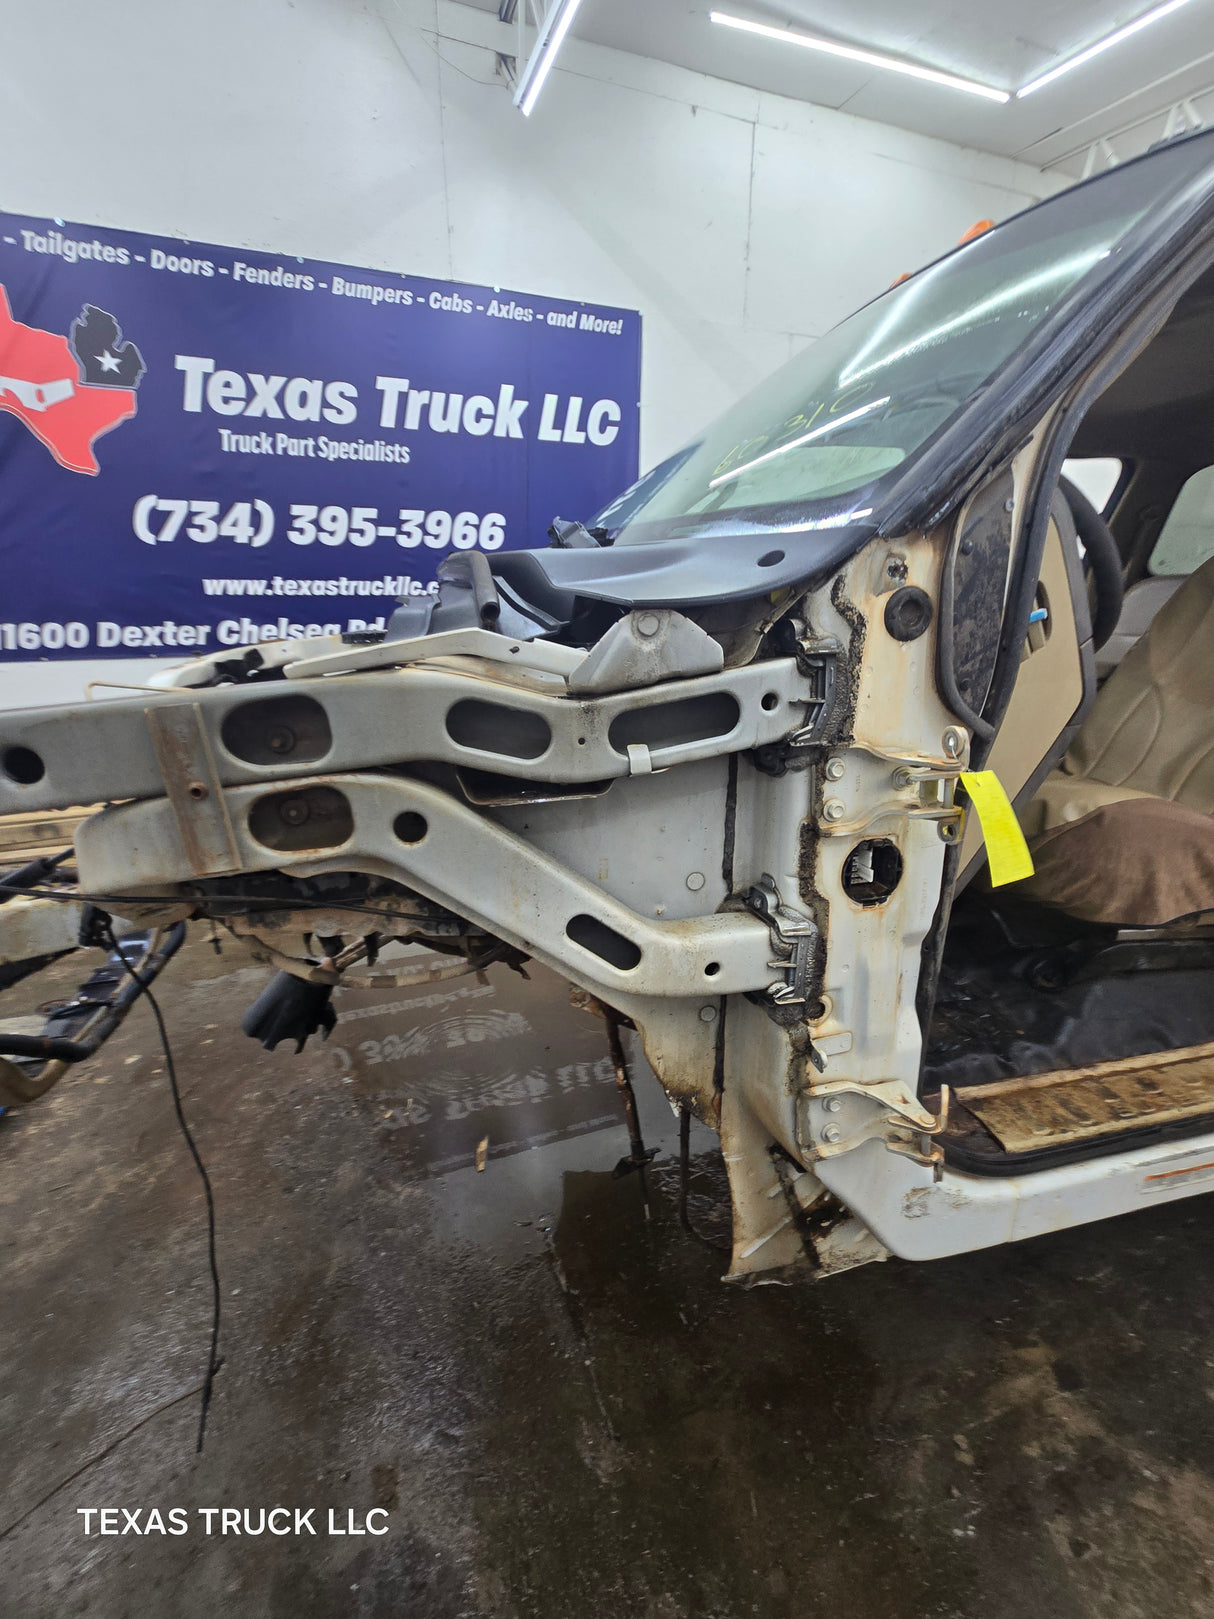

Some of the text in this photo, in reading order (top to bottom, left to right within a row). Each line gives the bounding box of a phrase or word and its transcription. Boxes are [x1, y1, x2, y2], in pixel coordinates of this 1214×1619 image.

[20, 229, 131, 265] Tailgates
[150, 248, 215, 277] Doors
[233, 261, 316, 291] Fenders
[331, 276, 413, 306] Bumpers
[429, 291, 473, 315] Cabs
[486, 299, 534, 323] Axles
[546, 311, 577, 329] and
[579, 313, 624, 336] More!
[174, 354, 622, 447] Texas Truck LLC
[218, 428, 411, 464] Truck Part Specialists
[132, 494, 507, 550] (734) 395-3966
[0, 622, 90, 650] 1600
[96, 620, 212, 648] Dexter
